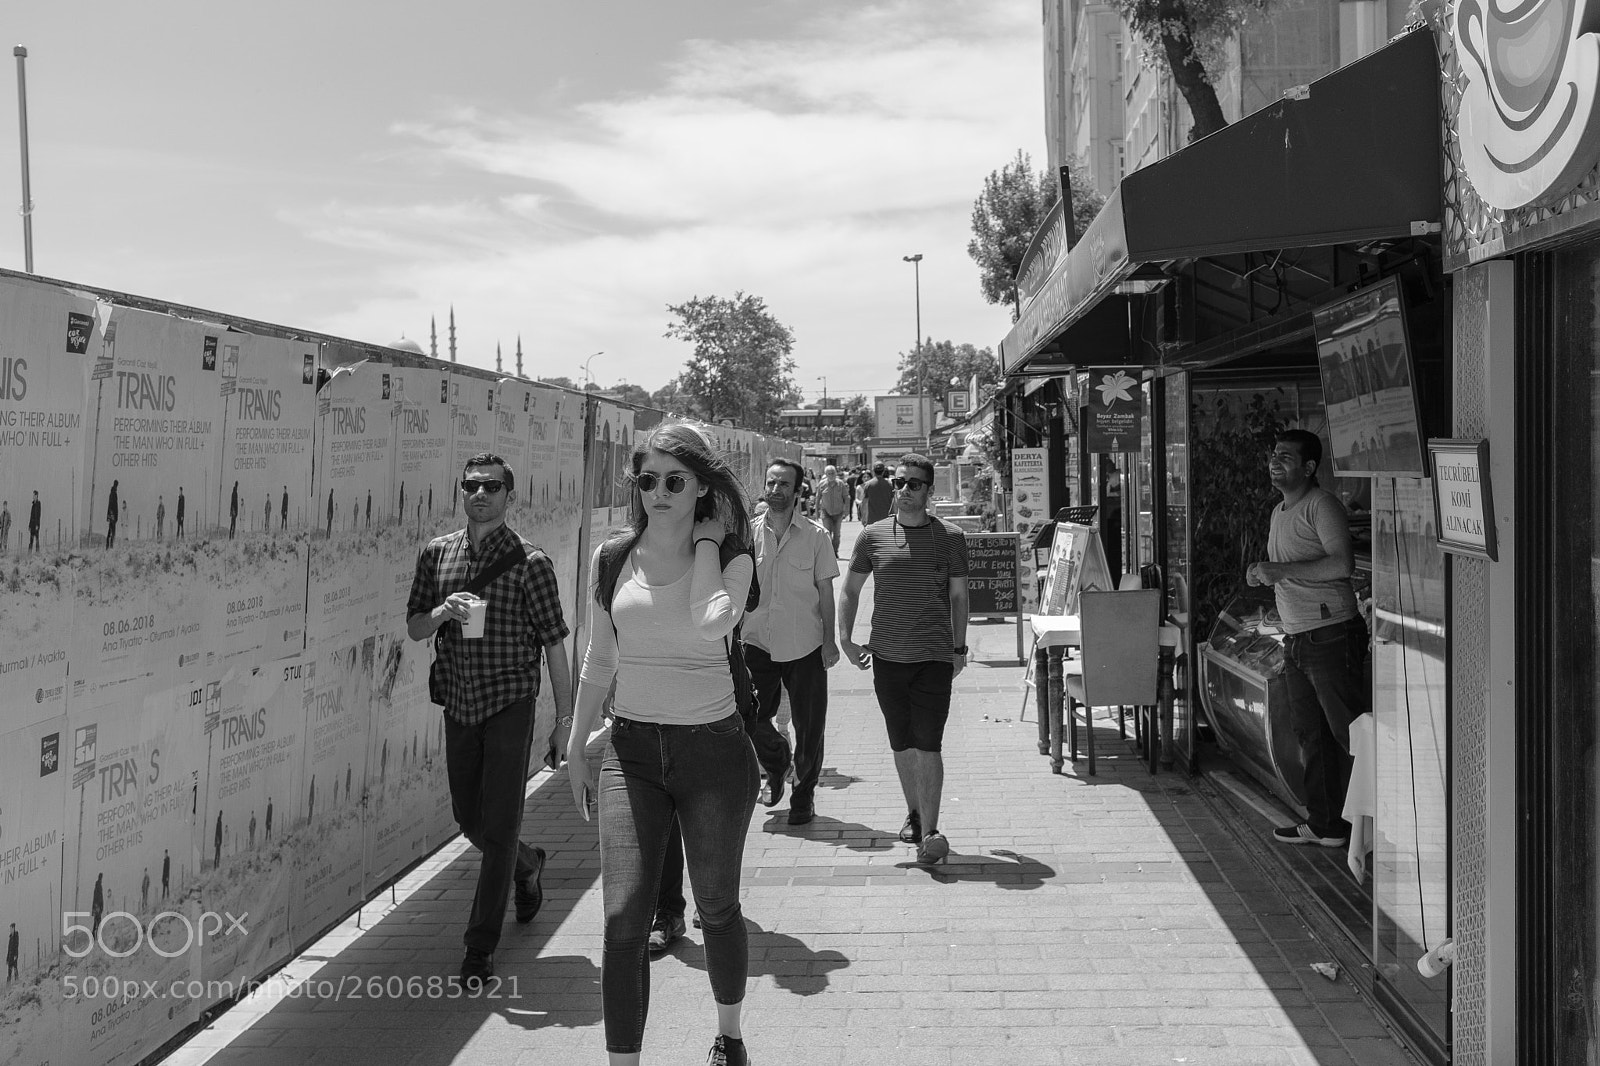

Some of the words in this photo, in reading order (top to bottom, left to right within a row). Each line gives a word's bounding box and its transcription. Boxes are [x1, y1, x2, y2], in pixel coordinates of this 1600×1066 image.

[116, 371, 176, 412] TRAVIS
[237, 387, 282, 422] TRAVIS
[20, 411, 46, 428] THEIR
[46, 413, 80, 429] ALBUM
[113, 417, 169, 433] PERFORMING
[170, 420, 188, 433] THEIR
[188, 421, 212, 434] ALBUM
[331, 406, 366, 436] TRAVIS
[402, 408, 430, 434] TRAVIS
[457, 412, 478, 437] TRAVIS
[29, 431, 39, 447] IN
[41, 432, 62, 448] FULL
[132, 435, 154, 450] MAN
[176, 436, 184, 450] IN
[184, 436, 199, 450] FULL
[235, 428, 274, 441] PERFORMING
[112, 452, 140, 468] OTHER
[141, 453, 158, 467] HITS
[233, 457, 253, 471] OTHER
[253, 457, 267, 470] HITS
[1450, 488, 1472, 508] KOMİ
[1445, 515, 1483, 536] ALINACAK
[226, 595, 264, 615] 08.06.2018
[103, 614, 155, 637] 08.06.2018
[102, 640, 119, 654] Ana
[119, 636, 143, 651] Tiyatro
[37, 650, 66, 666] Ayakta
[221, 706, 267, 751] TRAVIS
[22, 829, 57, 859] ALBUM
[96, 837, 125, 862] OTHER
[126, 830, 144, 849] HITS
[4, 866, 16, 886] IN
[17, 855, 39, 879] FULL
